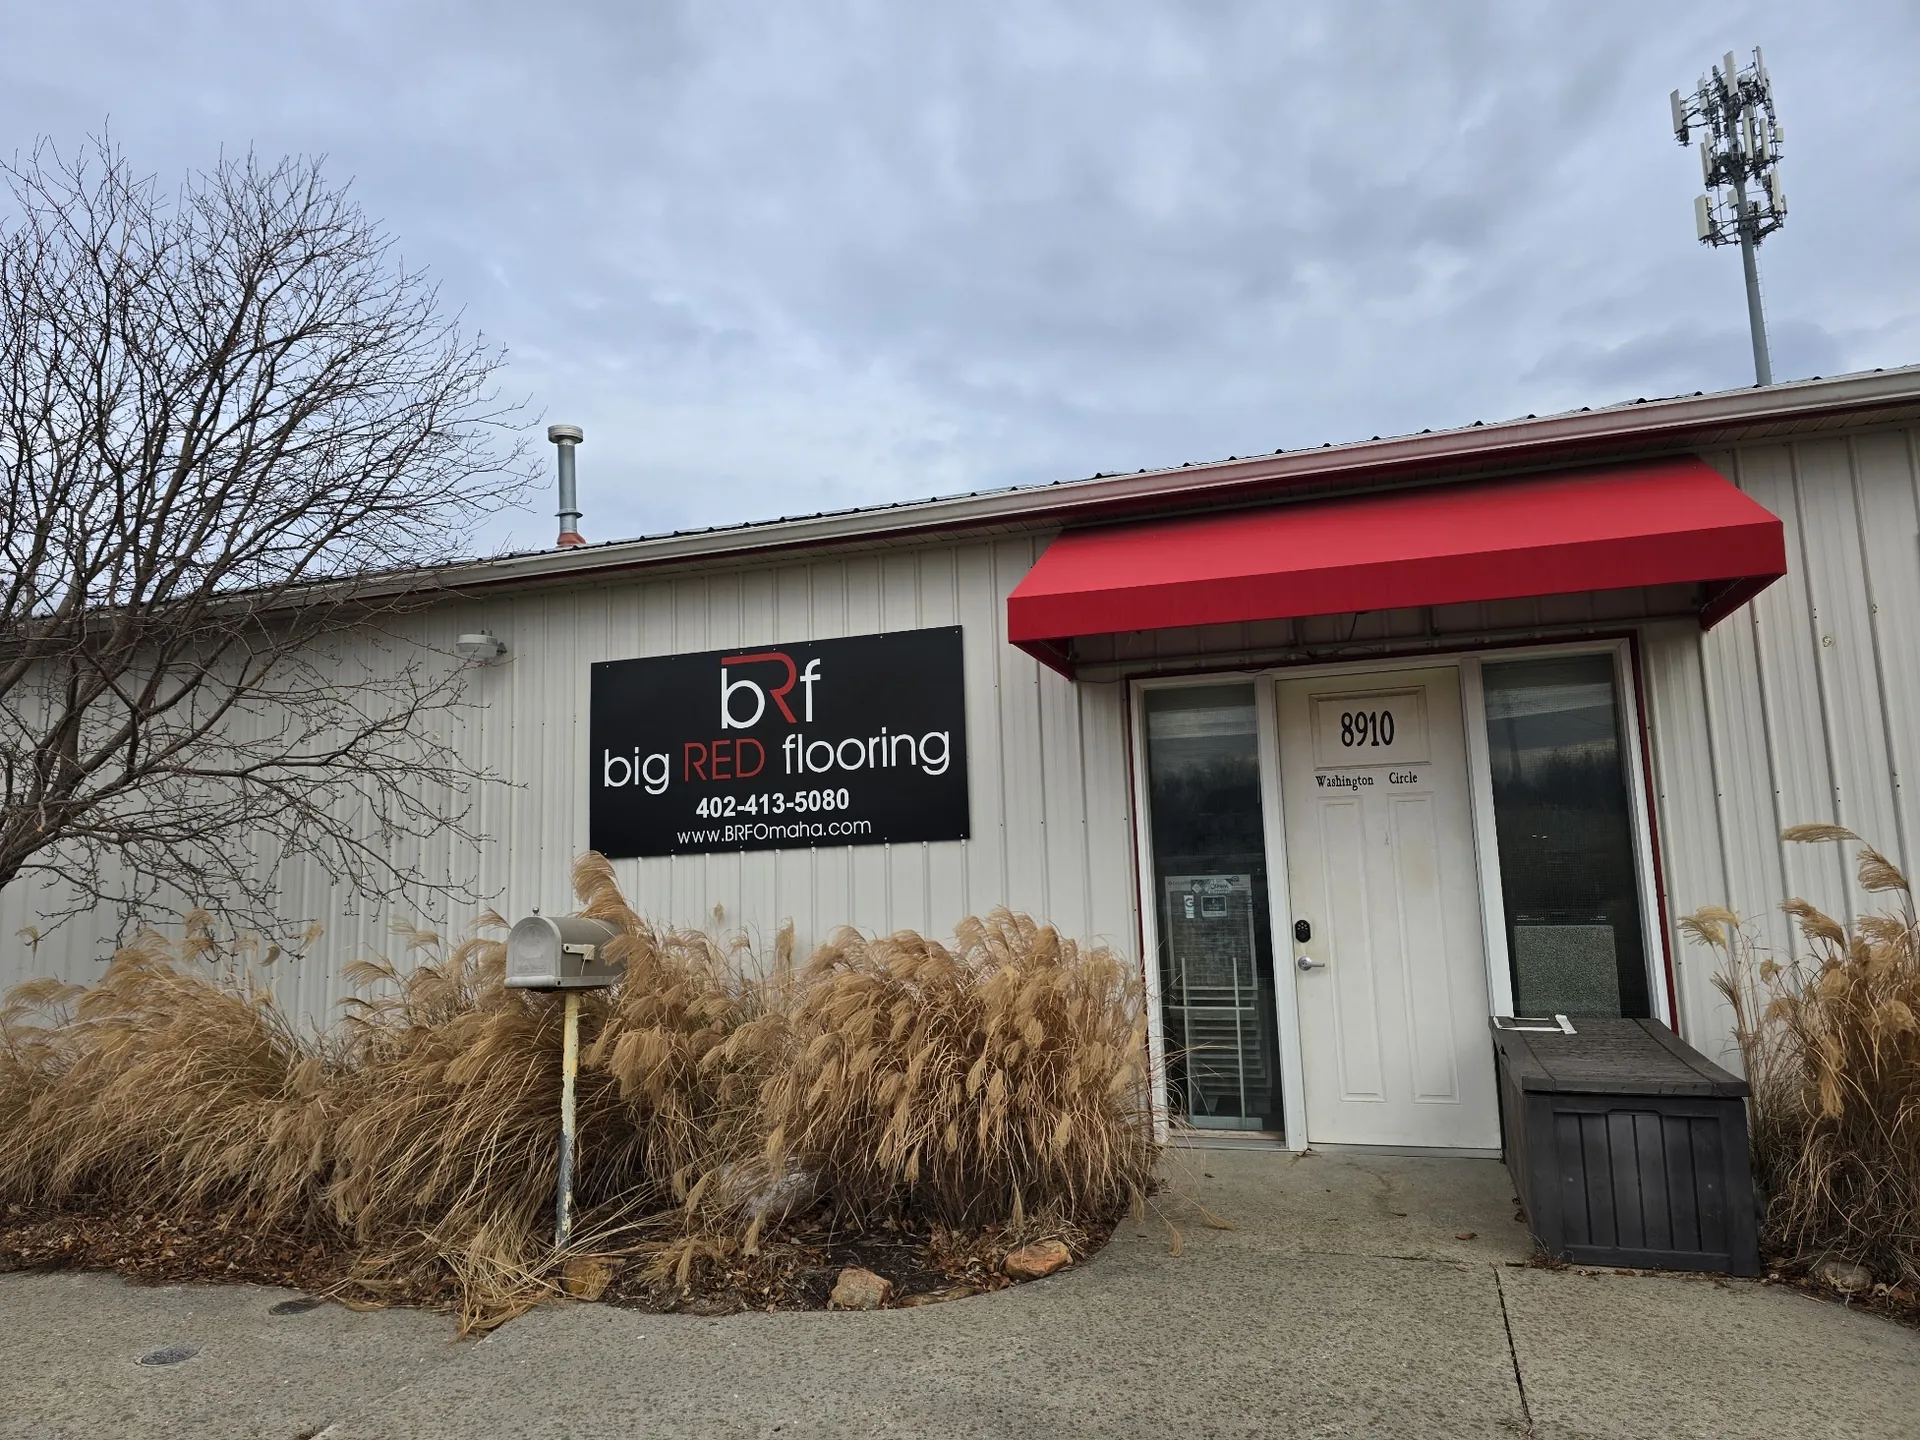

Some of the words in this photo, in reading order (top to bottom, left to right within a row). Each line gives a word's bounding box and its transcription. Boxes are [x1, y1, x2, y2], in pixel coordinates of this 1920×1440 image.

[1341, 710, 1394, 747] 8910
[604, 746, 670, 795] big
[683, 738, 766, 782] RED
[782, 726, 950, 775] flooring
[1315, 774, 1375, 791] Washington
[1388, 771, 1418, 784] Circle
[696, 788, 850, 818] 402-413-5080
[677, 820, 872, 844] www.BRFOmaha.com
